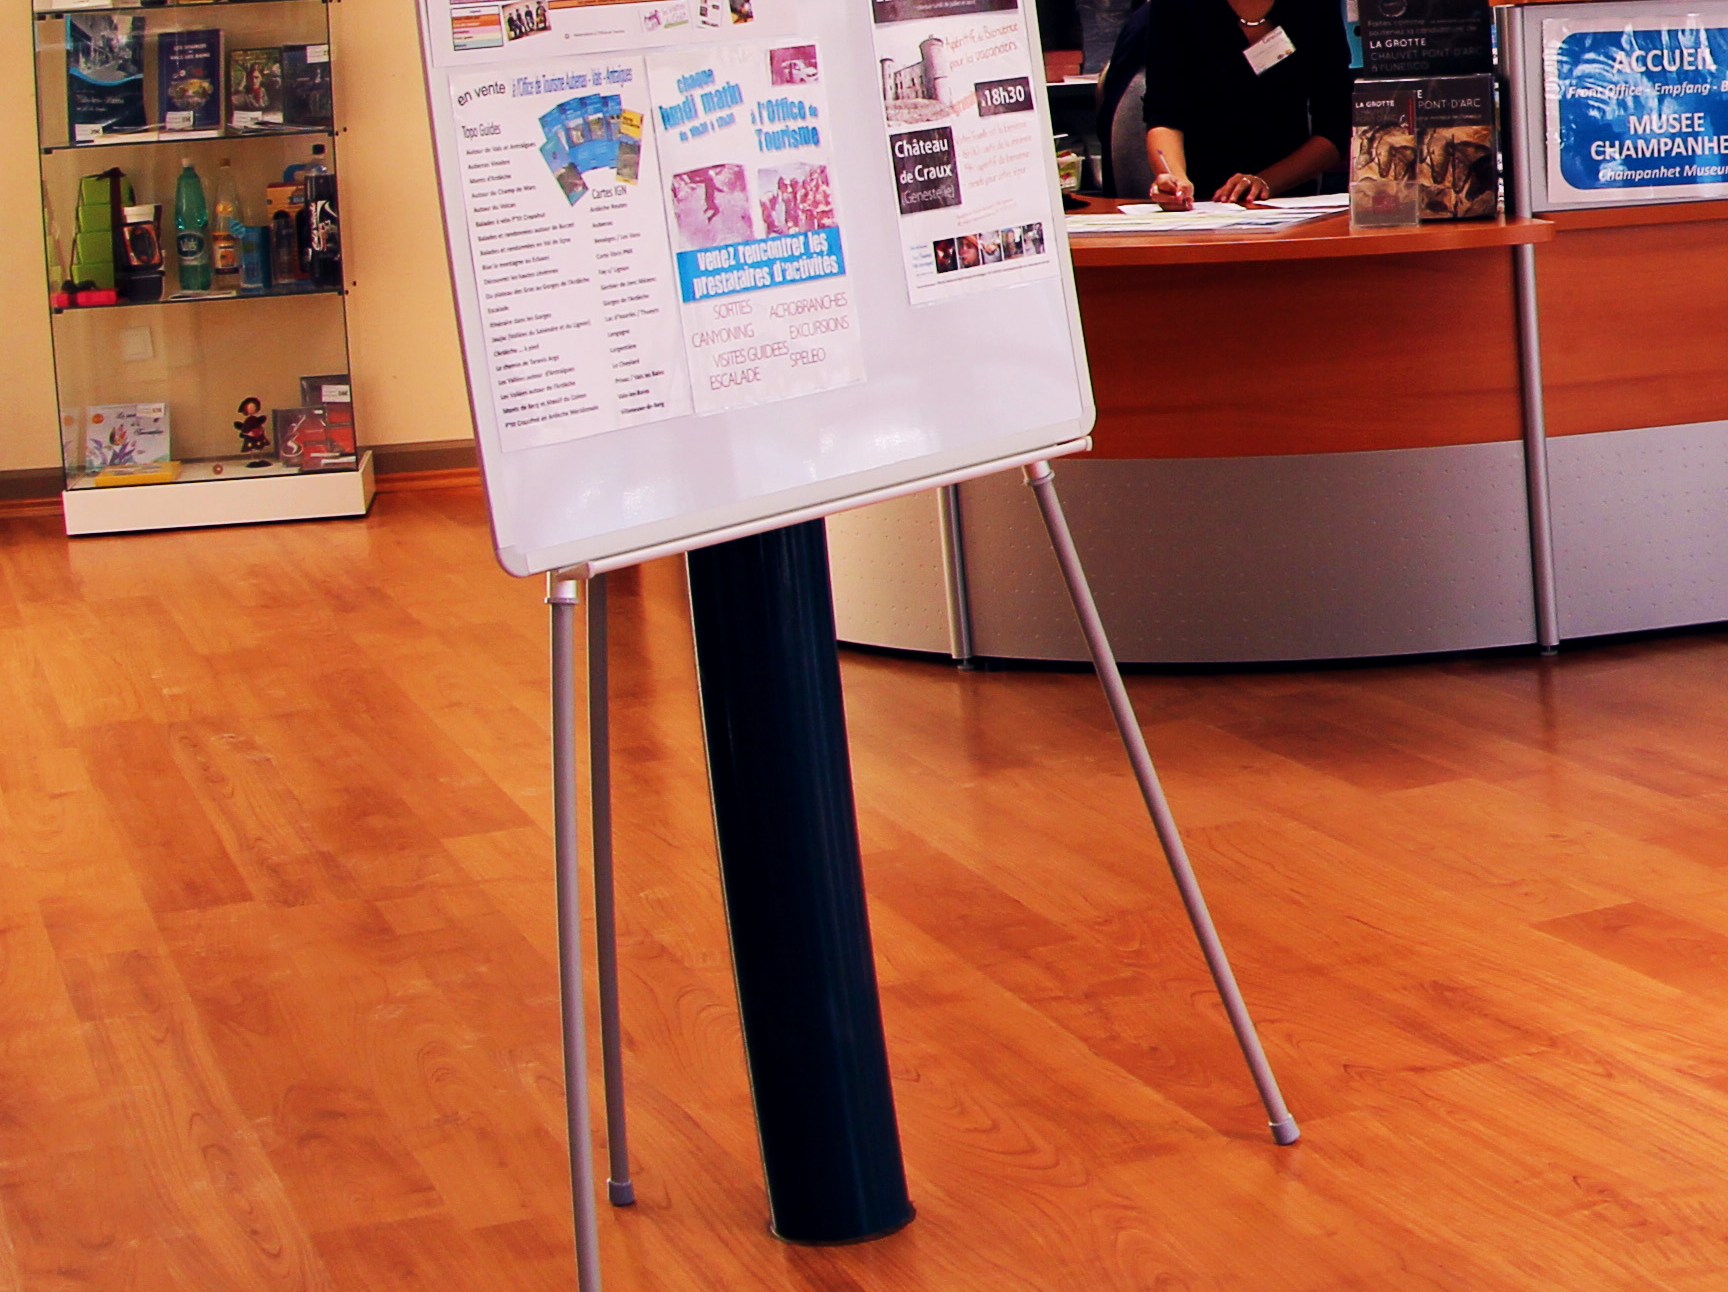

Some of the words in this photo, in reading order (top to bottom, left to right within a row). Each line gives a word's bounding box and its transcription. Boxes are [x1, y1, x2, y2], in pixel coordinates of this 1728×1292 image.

[1370, 40, 1381, 49] LA
[1385, 38, 1426, 48] GROTTE
[1612, 48, 1717, 73] ACCUEIL
[677, 68, 715, 93] chaque
[1568, 85, 1602, 99] Front
[1606, 83, 1642, 100] Office
[1654, 81, 1710, 96] Empfang
[457, 91, 473, 106] en
[474, 81, 506, 98] vente
[985, 85, 1026, 106] 18h30
[1366, 100, 1394, 108] GROTTE
[659, 94, 698, 131] lundi
[701, 81, 744, 114] matin
[757, 97, 806, 125] l'Office
[1628, 112, 1705, 135] MUSEE
[755, 125, 820, 152] Tourisme
[894, 138, 949, 158] Château
[900, 169, 914, 184] de
[914, 163, 953, 182] Craux
[1598, 165, 1680, 182] Champanhet
[697, 247, 735, 271] venez
[738, 236, 805, 263] rencontrer
[807, 231, 828, 254] les
[693, 266, 771, 299] prestataires
[773, 255, 840, 283] d'activités
[713, 299, 752, 320] SORTIES
[691, 323, 755, 348] CANYONING
[789, 315, 850, 340] EXCURSIONS
[712, 348, 747, 368] VISITES
[747, 341, 789, 362] GUIDEES
[789, 347, 826, 368] SPELEO
[709, 367, 761, 390] ESCALADE
